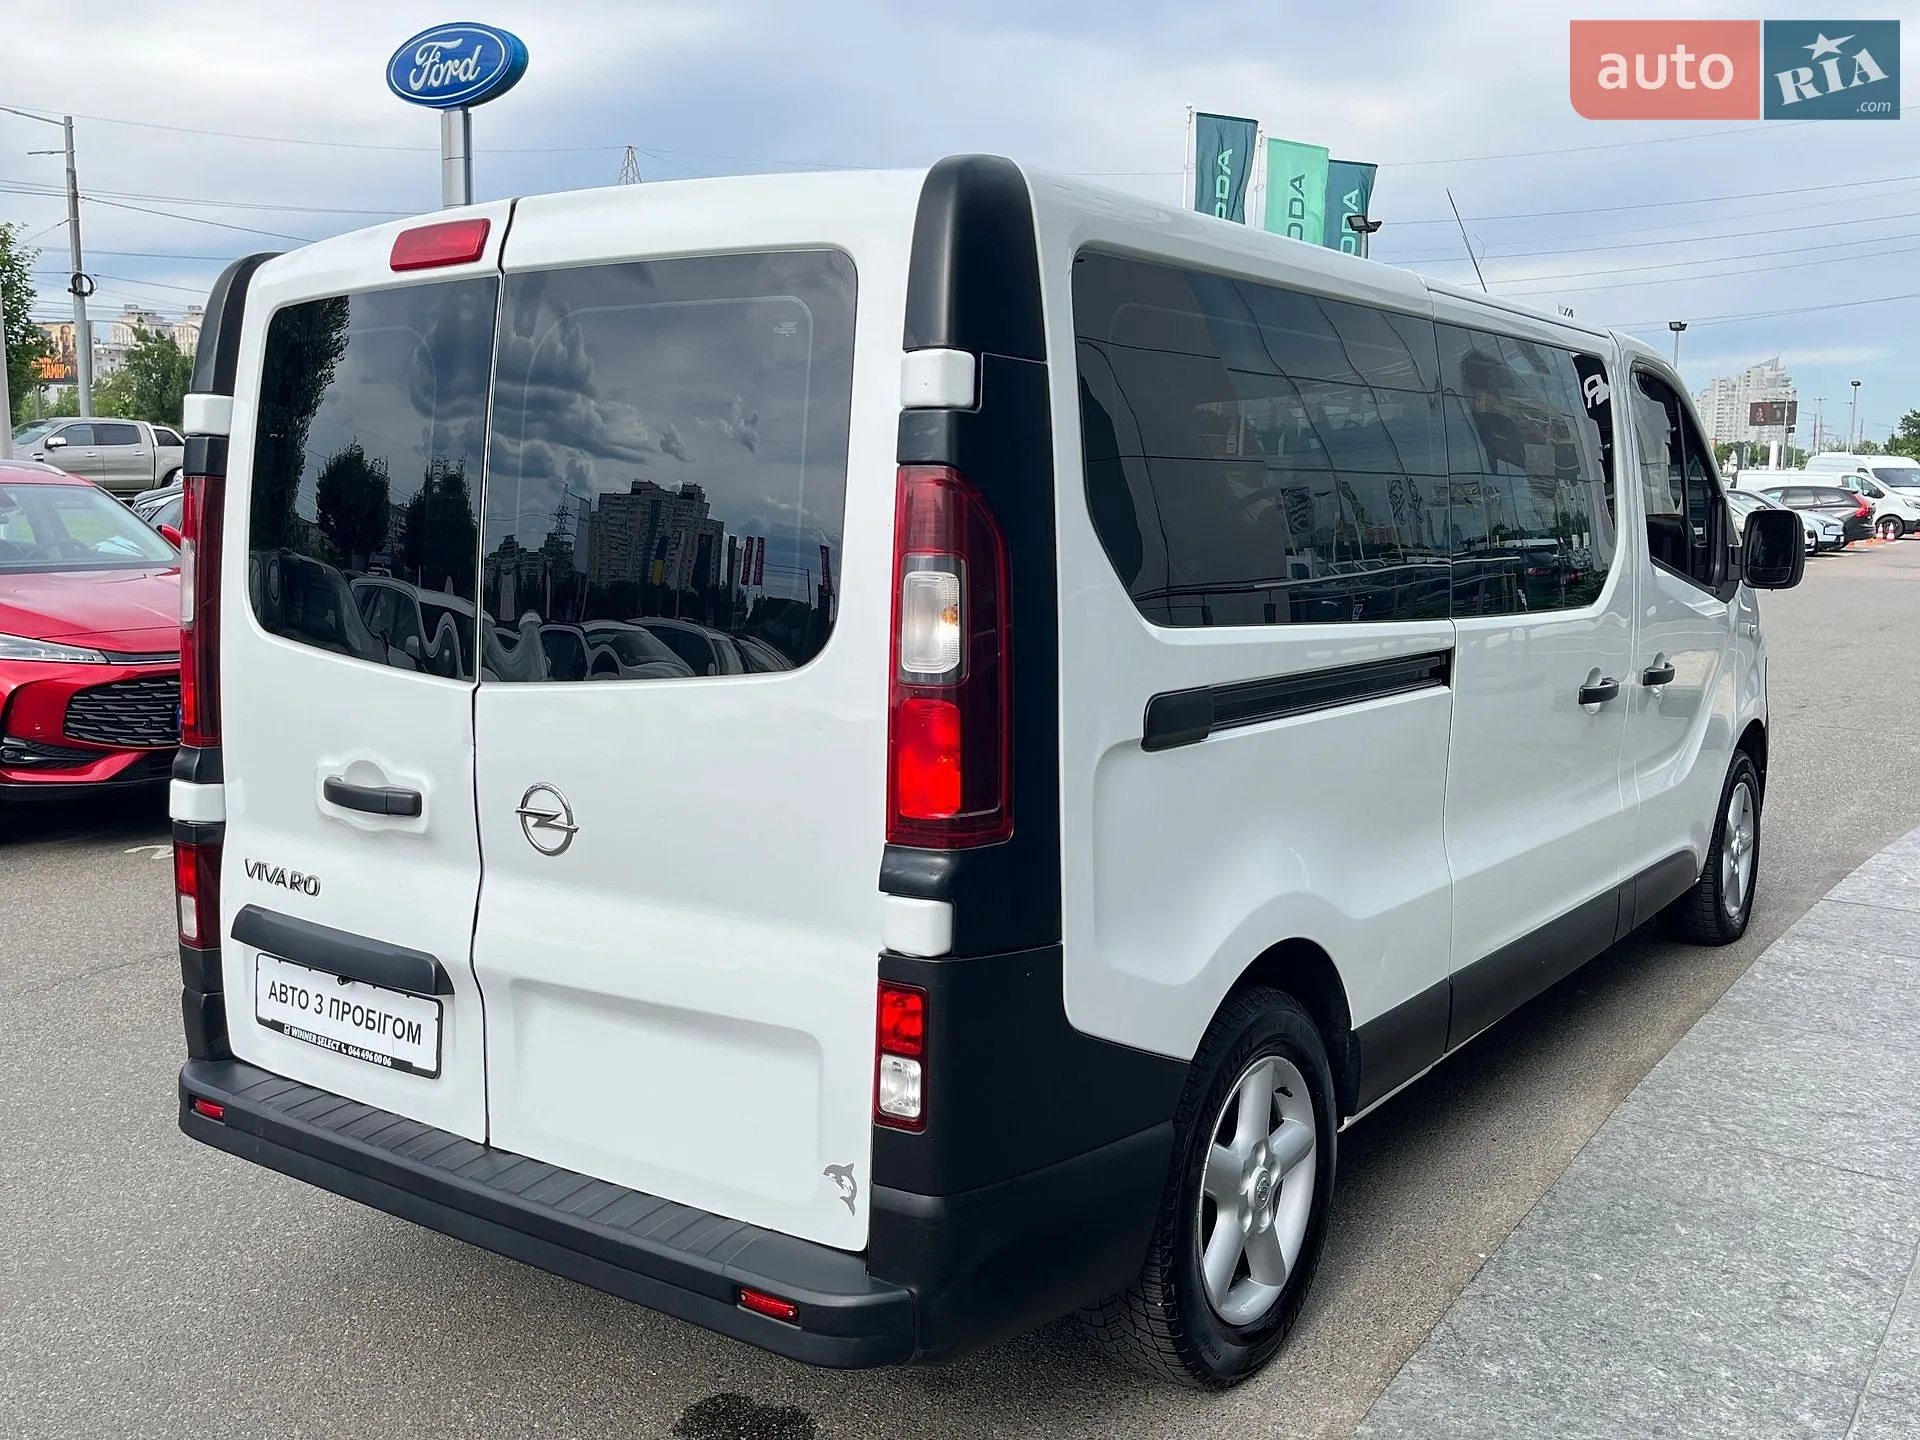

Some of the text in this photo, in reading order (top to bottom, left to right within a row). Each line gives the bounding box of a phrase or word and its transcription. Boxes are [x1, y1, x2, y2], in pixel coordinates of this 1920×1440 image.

[409, 38, 483, 91] Ford
[244, 857, 321, 897] VIVARO
[268, 980, 310, 1010] АВТО
[328, 997, 422, 1046] ПРОБІГОМ
[291, 1026, 392, 1067] WINNER SELECT 044 496 00 06
